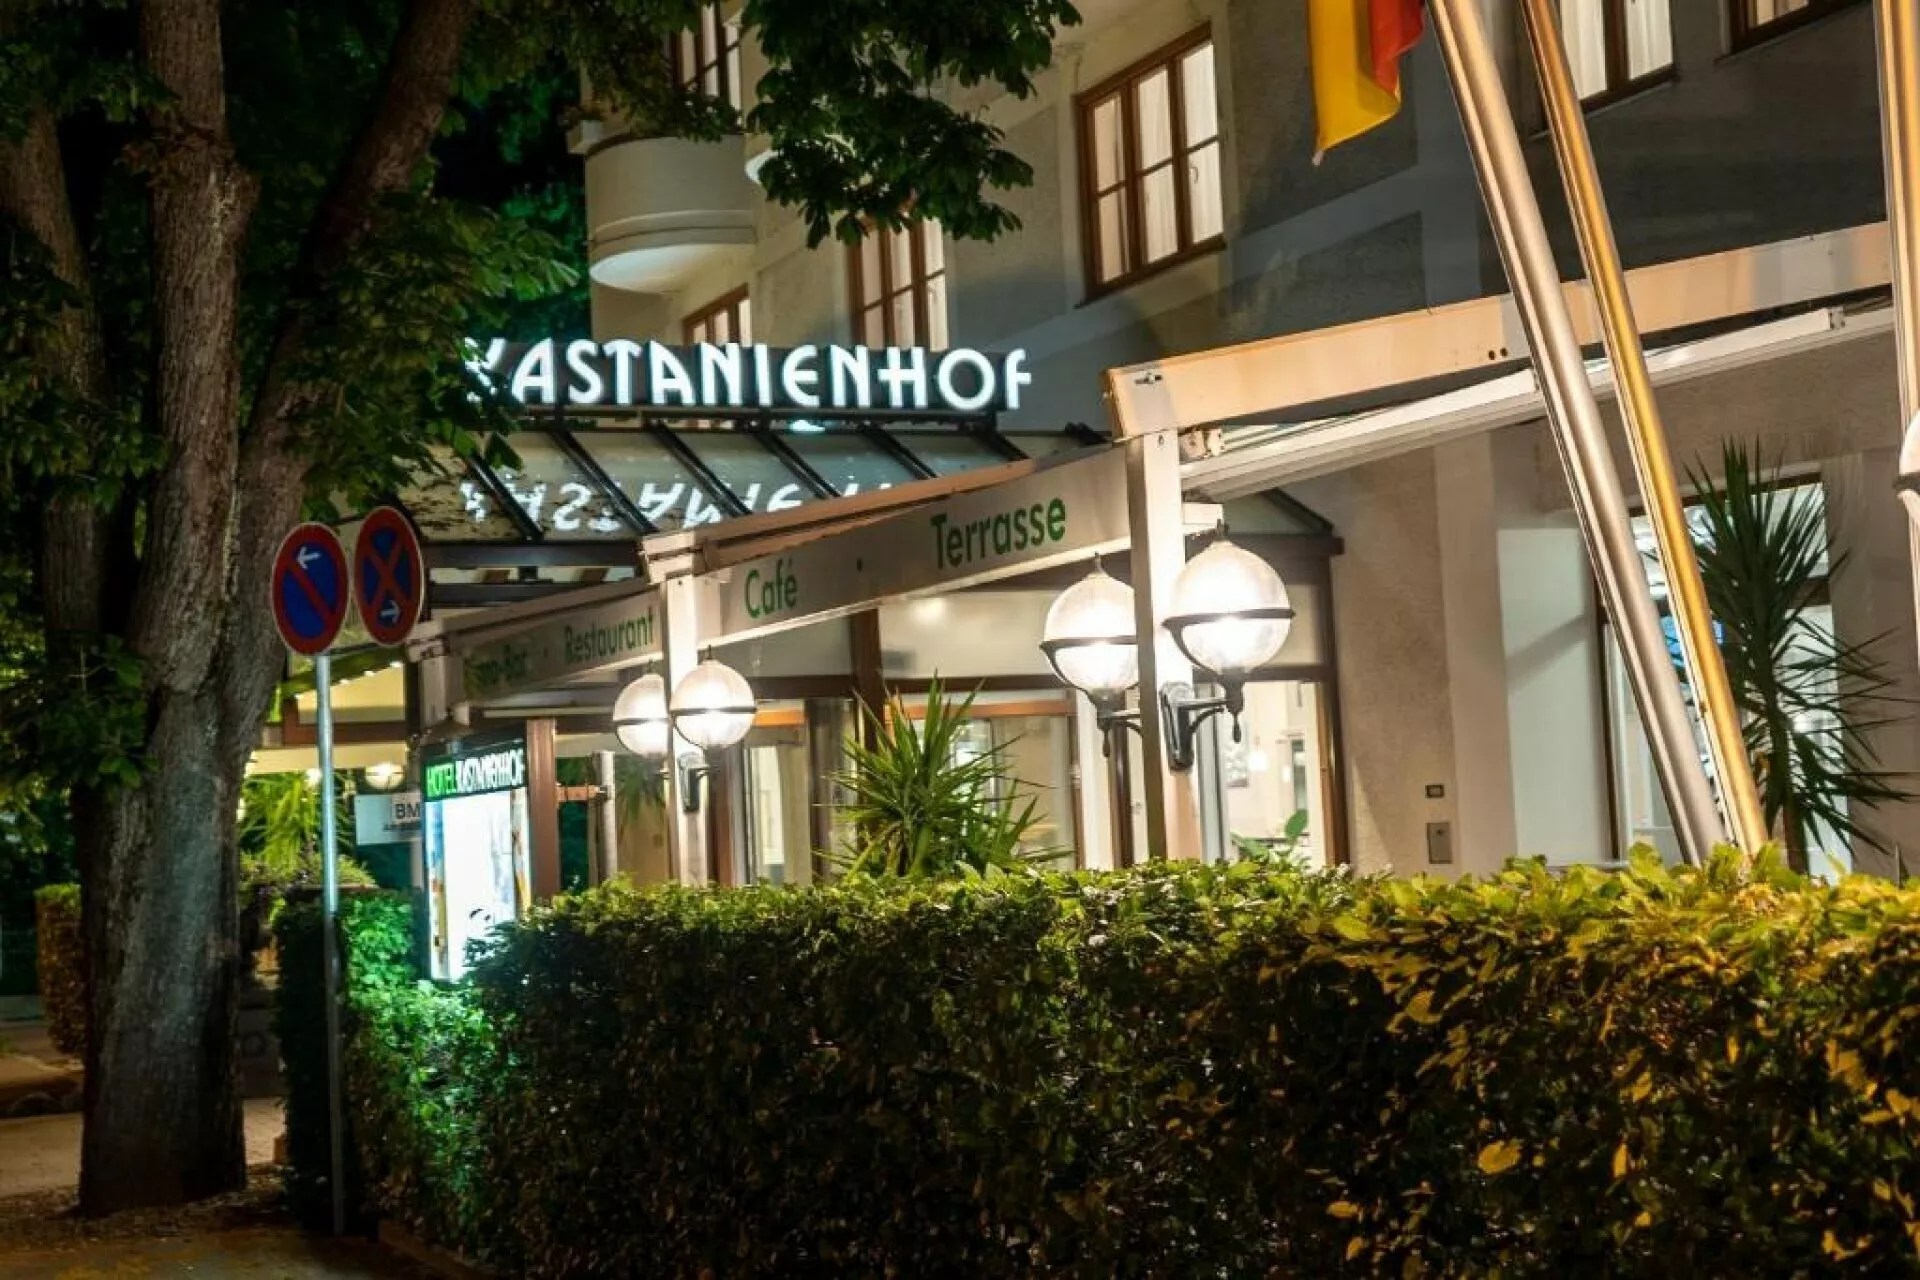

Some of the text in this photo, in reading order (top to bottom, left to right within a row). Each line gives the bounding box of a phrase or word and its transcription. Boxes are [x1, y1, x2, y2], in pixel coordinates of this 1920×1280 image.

[745, 559, 797, 617] Café
[931, 498, 1065, 568] Terrasse
[564, 608, 653, 663] Restaurant
[427, 763, 457, 797] HOTEL
